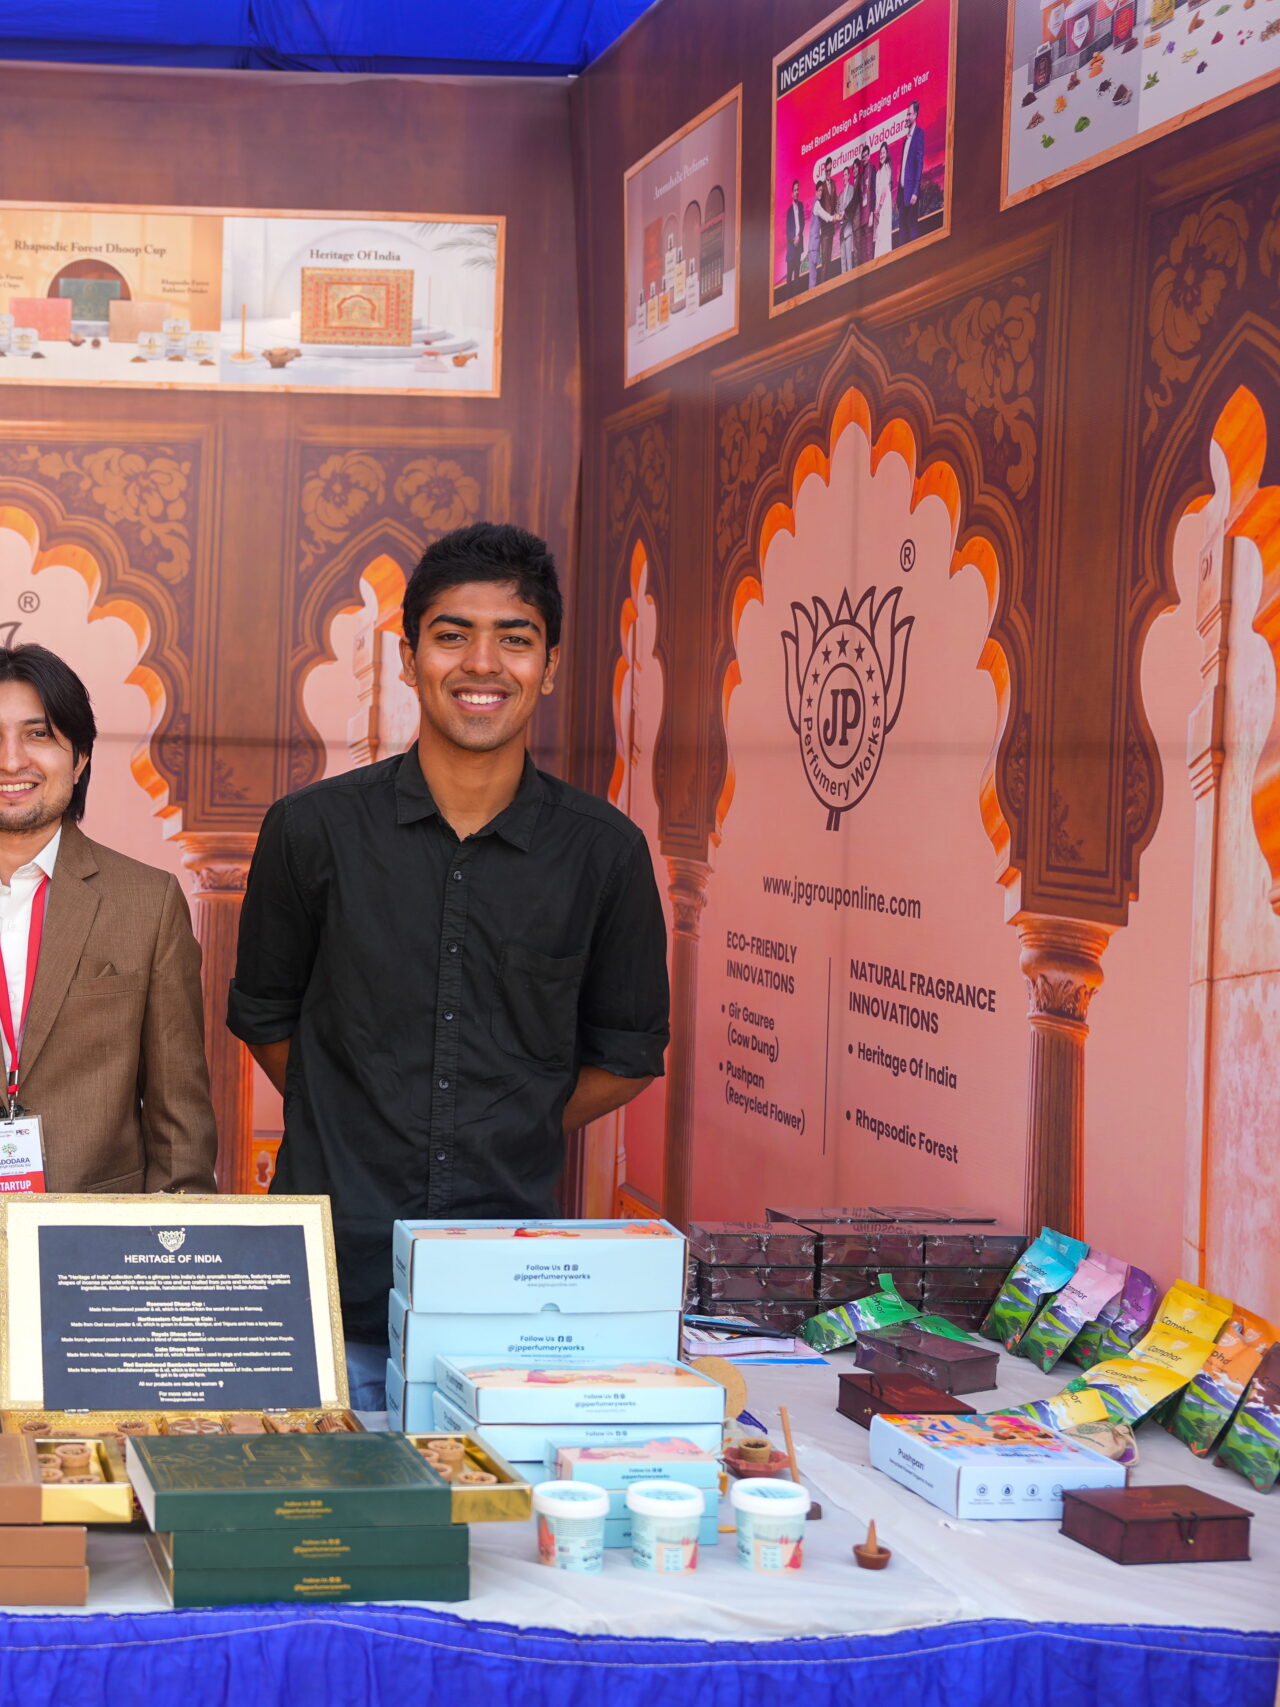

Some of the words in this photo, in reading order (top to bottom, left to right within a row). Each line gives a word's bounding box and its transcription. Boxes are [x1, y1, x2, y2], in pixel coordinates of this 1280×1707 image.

[780, 41, 826, 91] INCENSE
[828, 15, 864, 57] MEDIA
[866, 0, 910, 30] AWAR
[801, 141, 814, 156] Best
[815, 129, 831, 146] Brand
[832, 119, 852, 138] Design
[853, 113, 858, 124] &
[859, 94, 892, 122] Packaging
[892, 86, 901, 100] of
[901, 81, 912, 96] the
[913, 71, 930, 87] Year
[14, 239, 68, 254] Rhapsodic
[71, 242, 103, 253] Forest
[105, 243, 142, 256] Dhoop
[144, 244, 167, 257] Cup
[310, 248, 354, 262] Heritage
[357, 250, 371, 260] Of
[374, 250, 401, 262] India
[823, 688, 862, 746] JP
[803, 716, 851, 801] Perfumery
[851, 714, 881, 788] Works
[763, 874, 921, 919] www.jpgrouponline.com
[726, 930, 797, 964] ECO-FRIENDLY
[726, 959, 795, 994] INNOVATIONS
[849, 958, 907, 993] NATURAL
[910, 972, 996, 1013] FRAGRANCE
[728, 1001, 742, 1020] Gir
[742, 1004, 775, 1030] Gauree
[849, 991, 939, 1035] INNOVATIONS
[727, 1022, 750, 1048] (Cow
[751, 1034, 779, 1063] Dung)
[726, 1061, 765, 1089] Pushpan
[858, 1041, 907, 1077] Heritage
[909, 1057, 924, 1079] Of
[925, 1062, 957, 1090] India
[725, 1080, 769, 1116] (Recycled
[770, 1099, 806, 1136] Flower)
[855, 1108, 917, 1148] Rhapsodic
[919, 1132, 959, 1164] Forest
[124, 1254, 175, 1263] HERITAGE
[177, 1254, 192, 1263] OF
[194, 1254, 223, 1263] INDIA
[513, 1273, 591, 1282] @jpperfumeryworks
[507, 1344, 585, 1353] @jpperfumeryworks
[1147, 1345, 1182, 1362] Camphor
[1104, 1369, 1147, 1384] Camphor
